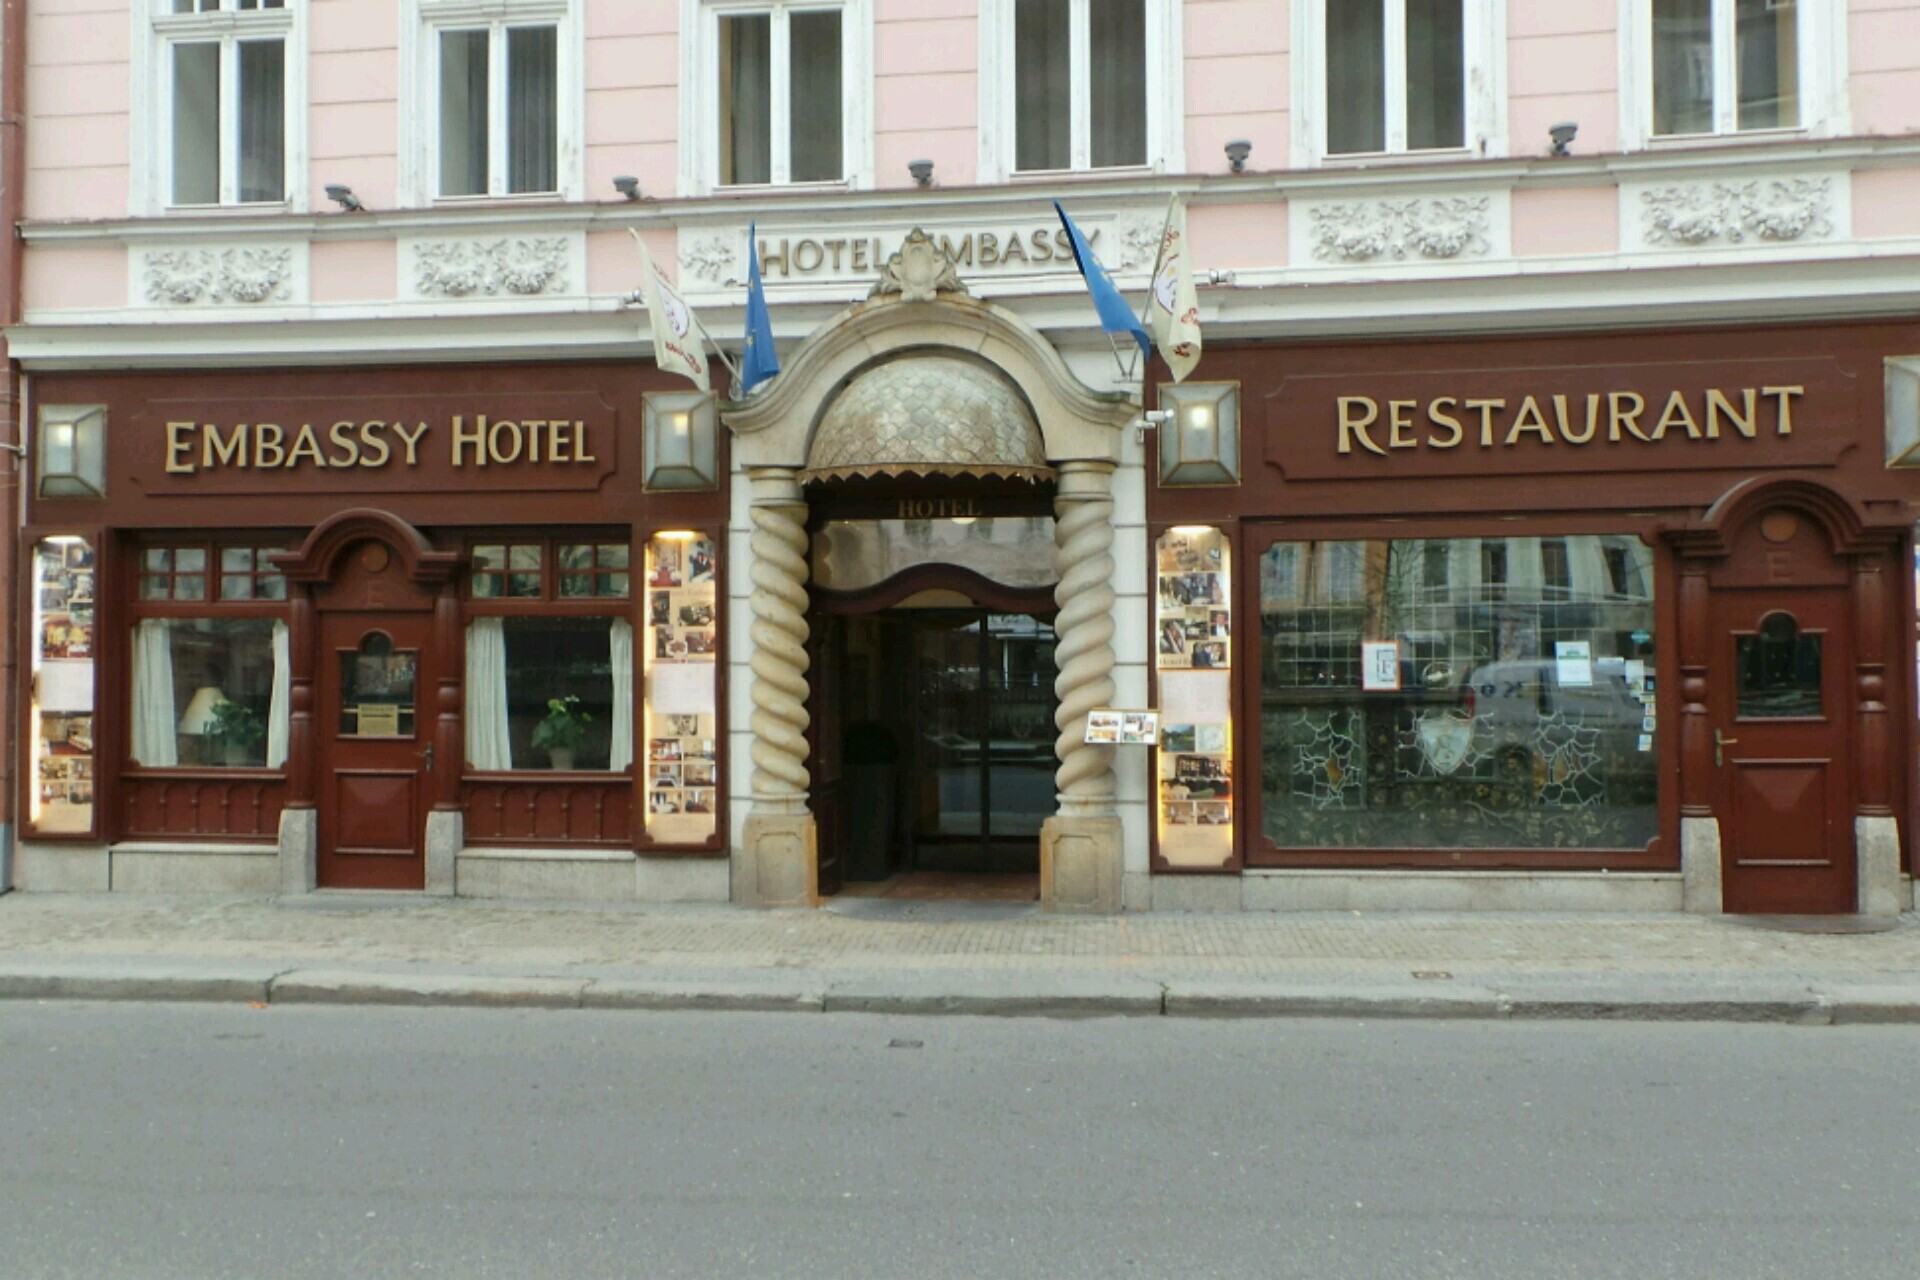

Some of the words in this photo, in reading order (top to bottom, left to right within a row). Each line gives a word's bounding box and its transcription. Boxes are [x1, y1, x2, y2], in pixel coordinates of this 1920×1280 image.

[758, 236, 889, 277] HOTEL
[165, 420, 428, 474] EMBASSY
[451, 414, 596, 467] HOTEL
[1336, 385, 1804, 457] RESTAURANT
[898, 498, 981, 518] HOTEL
